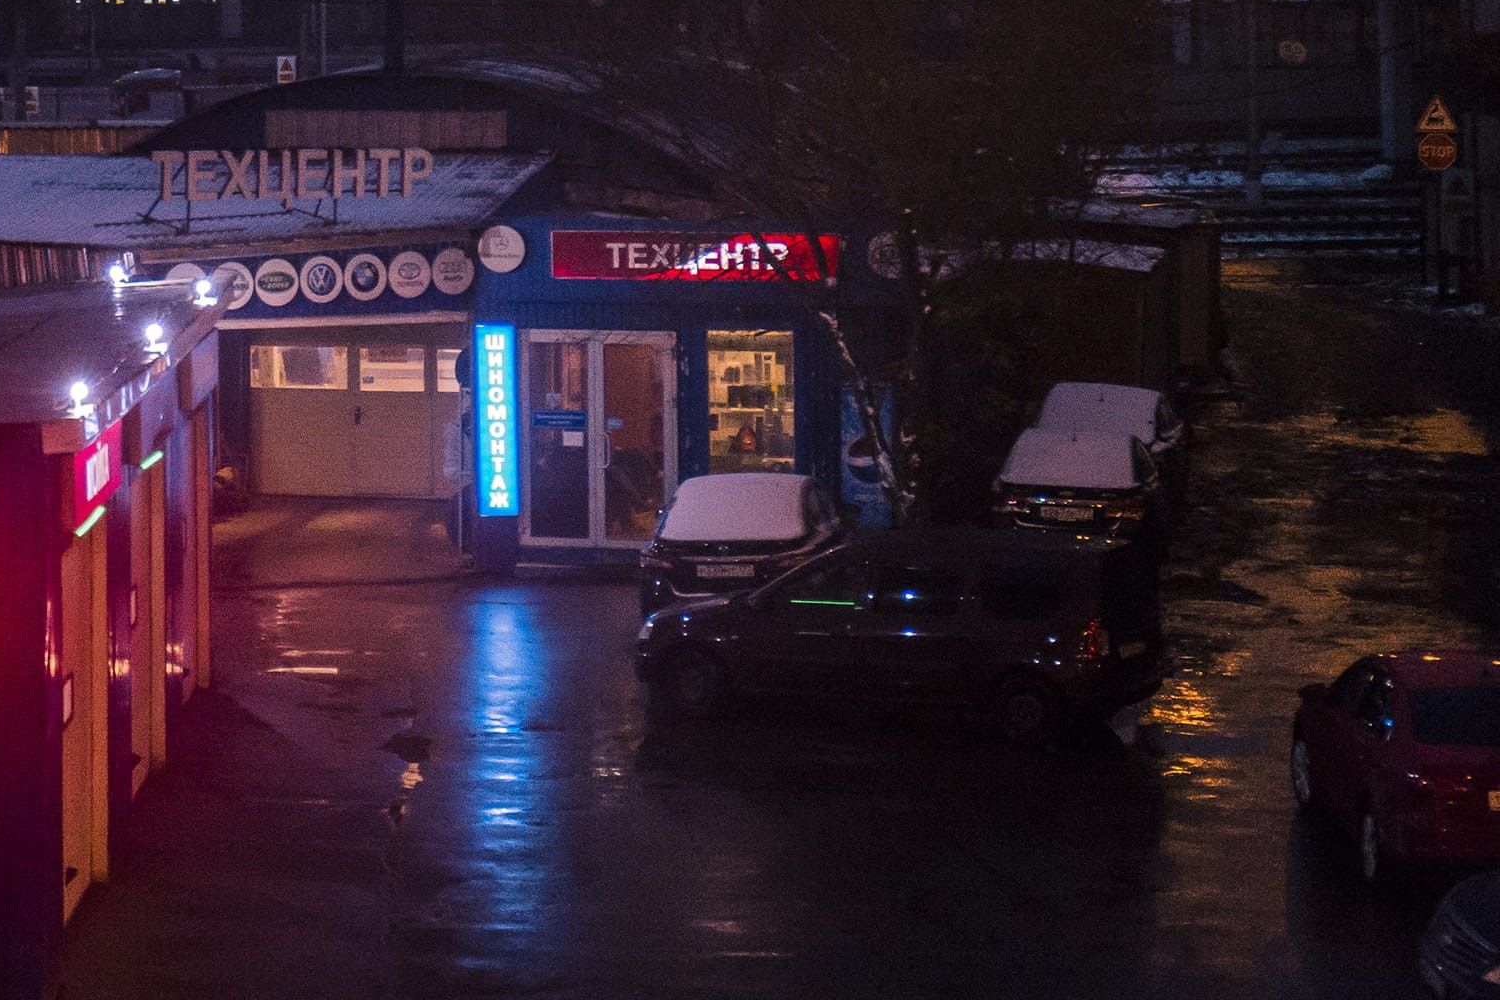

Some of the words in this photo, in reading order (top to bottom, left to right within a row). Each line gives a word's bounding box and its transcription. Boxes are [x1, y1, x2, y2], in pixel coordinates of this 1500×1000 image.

[1422, 145, 1454, 157] STOP
[151, 148, 434, 210] ТЕХЦЕНТР
[605, 242, 790, 276] ТЕХЦЕНТР
[484, 334, 510, 508] ШИНОМОНТАЖ
